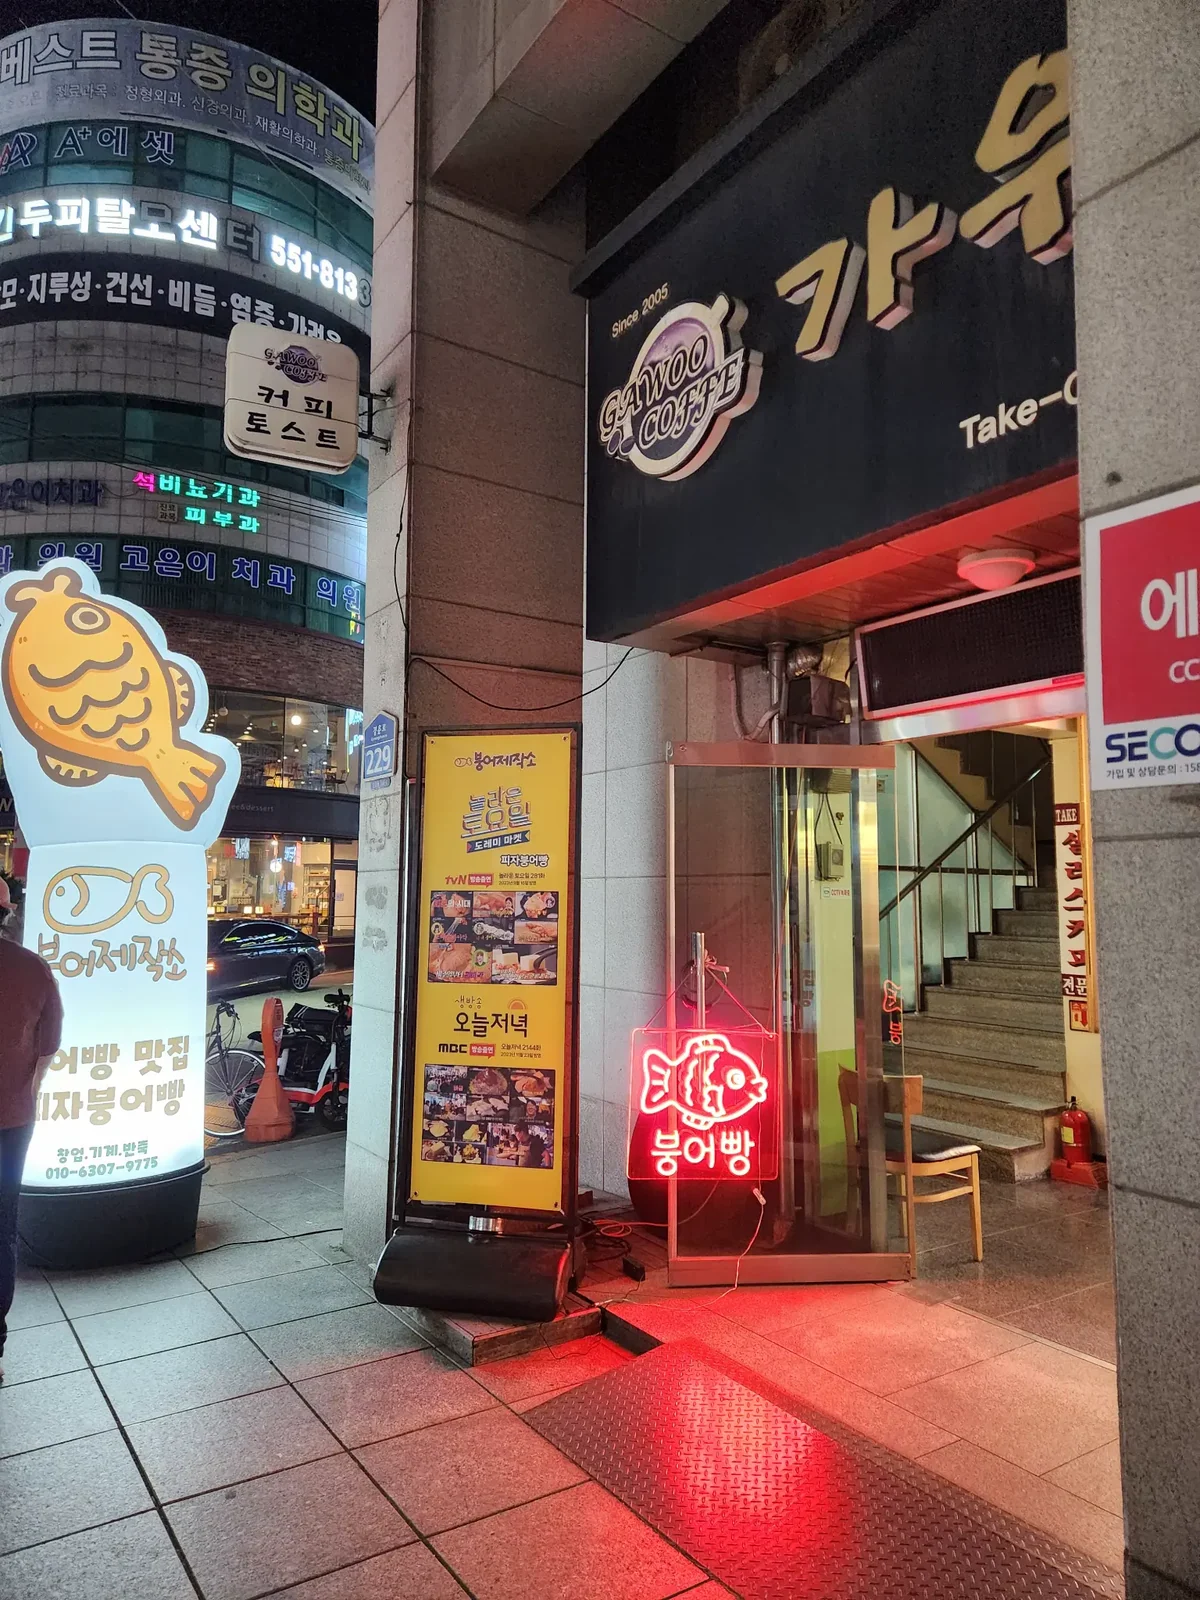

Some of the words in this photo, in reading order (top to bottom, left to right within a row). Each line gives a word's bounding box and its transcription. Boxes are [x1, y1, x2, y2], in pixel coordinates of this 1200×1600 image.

[1, 31, 121, 85] 베스트
[135, 31, 233, 91] 통증
[246, 63, 363, 161] 의학과
[270, 234, 371, 307] 551-8133
[612, 310, 639, 338] Since
[642, 282, 669, 315] 2005
[601, 334, 710, 441] GAWOO
[257, 385, 332, 420] 커피
[246, 411, 340, 450] 토스트
[184, 506, 260, 533] 피부과
[120, 545, 216, 581] 고은이
[232, 557, 296, 594] 치과
[316, 576, 361, 615] 의원
[366, 744, 391, 775] 229
[474, 751, 537, 771] 붕어제작소
[1106, 768, 1124, 779] 가입
[1126, 767, 1136, 778] 및
[460, 801, 533, 839] 토요일
[1055, 809, 1078, 822] TAKE
[474, 836, 500, 851] 도레미
[504, 832, 523, 845] 마켓
[499, 853, 550, 868] 피자붕어빵
[445, 874, 467, 885] tvN
[455, 995, 483, 1009] 생방송
[453, 1011, 529, 1038] 오늘저녁
[134, 1035, 189, 1076] 맛집
[438, 1043, 468, 1053] MBC
[650, 1128, 756, 1176] 붕어빵
[46, 1156, 158, 1180] 010-6307-9775
